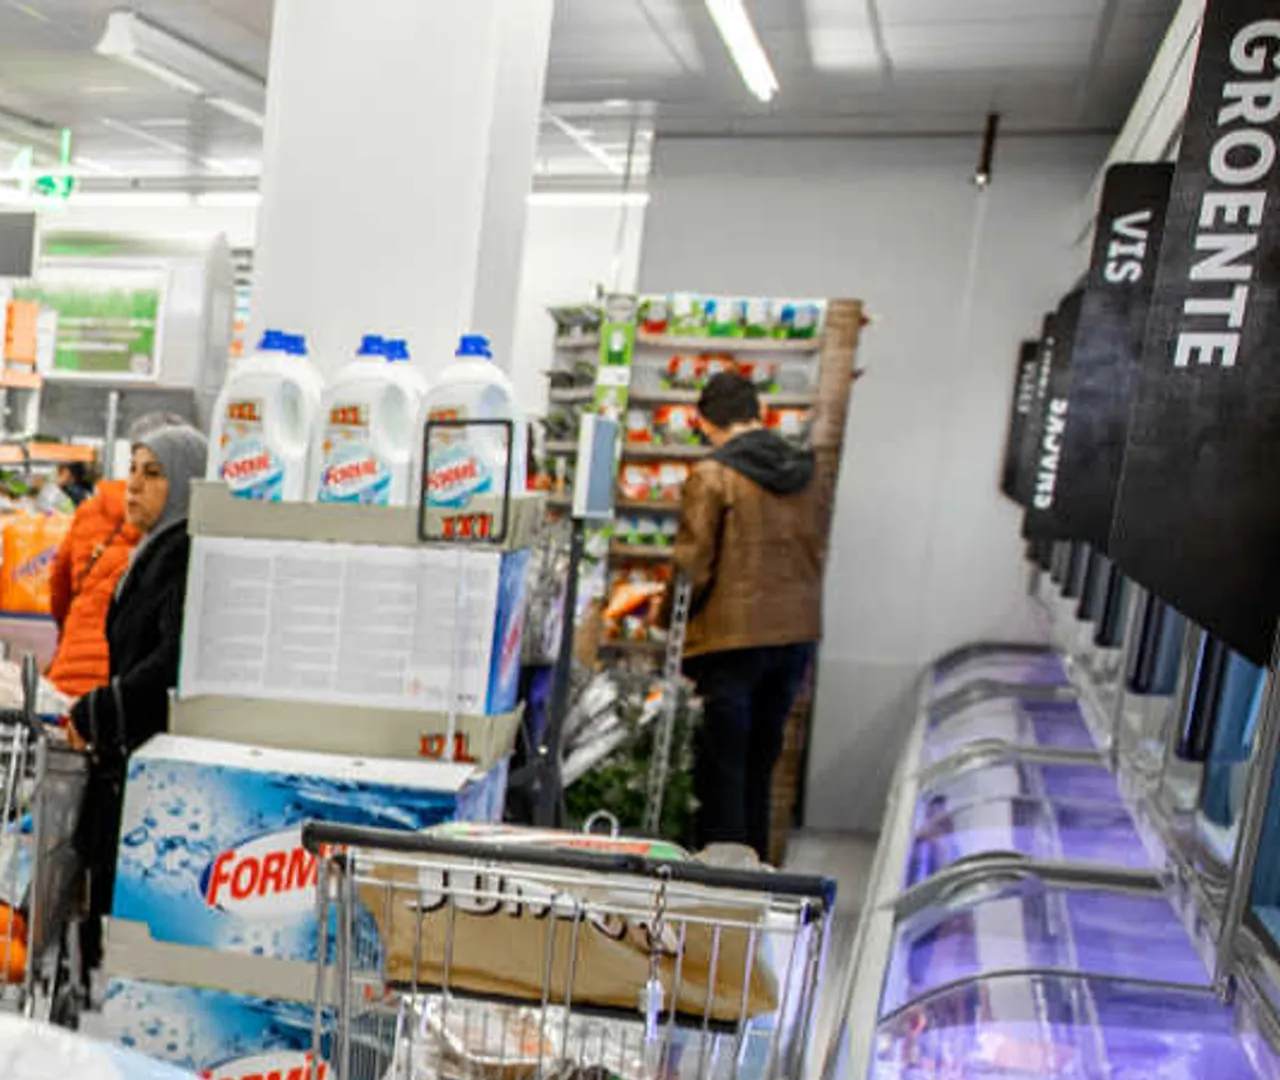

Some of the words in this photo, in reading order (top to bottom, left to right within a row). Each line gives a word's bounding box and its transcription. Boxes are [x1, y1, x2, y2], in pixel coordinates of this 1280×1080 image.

[1173, 18, 1280, 368] GROENTE
[1104, 210, 1152, 283] VIS
[1033, 398, 1069, 510] SNACKS
[207, 842, 347, 907] FORM
